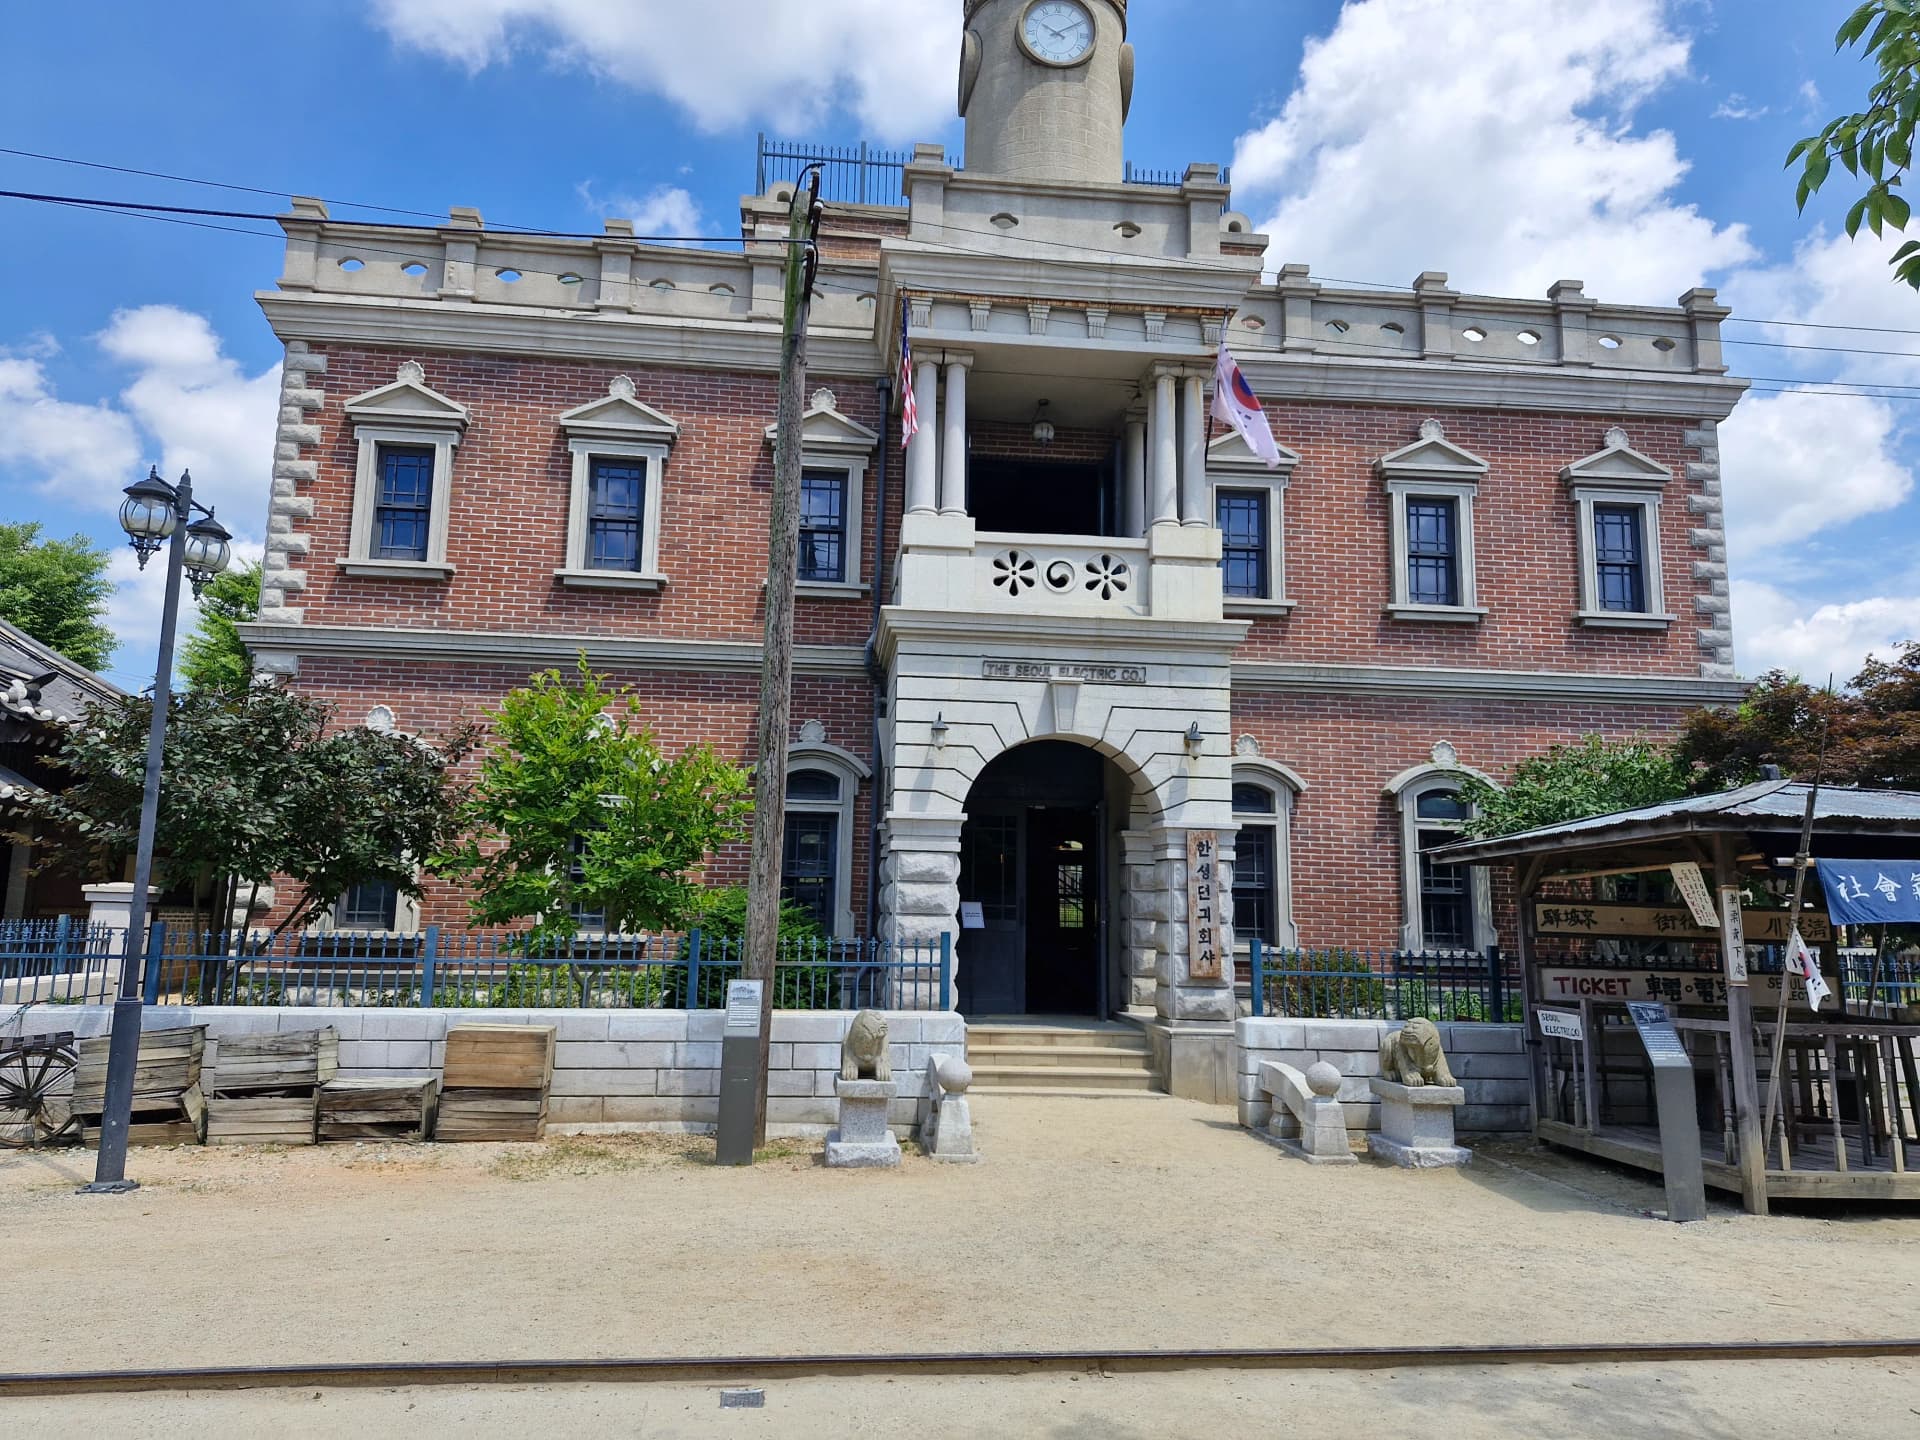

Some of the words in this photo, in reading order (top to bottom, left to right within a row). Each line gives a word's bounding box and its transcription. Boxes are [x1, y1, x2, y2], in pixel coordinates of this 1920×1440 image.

[986, 663, 1010, 676] THE
[1015, 664, 1053, 678] SEOUL
[1058, 666, 1117, 680] ELECTRIC
[1121, 669, 1142, 682] CO.
[1552, 976, 1631, 996] TICKET
[1768, 976, 1804, 990] SEUL
